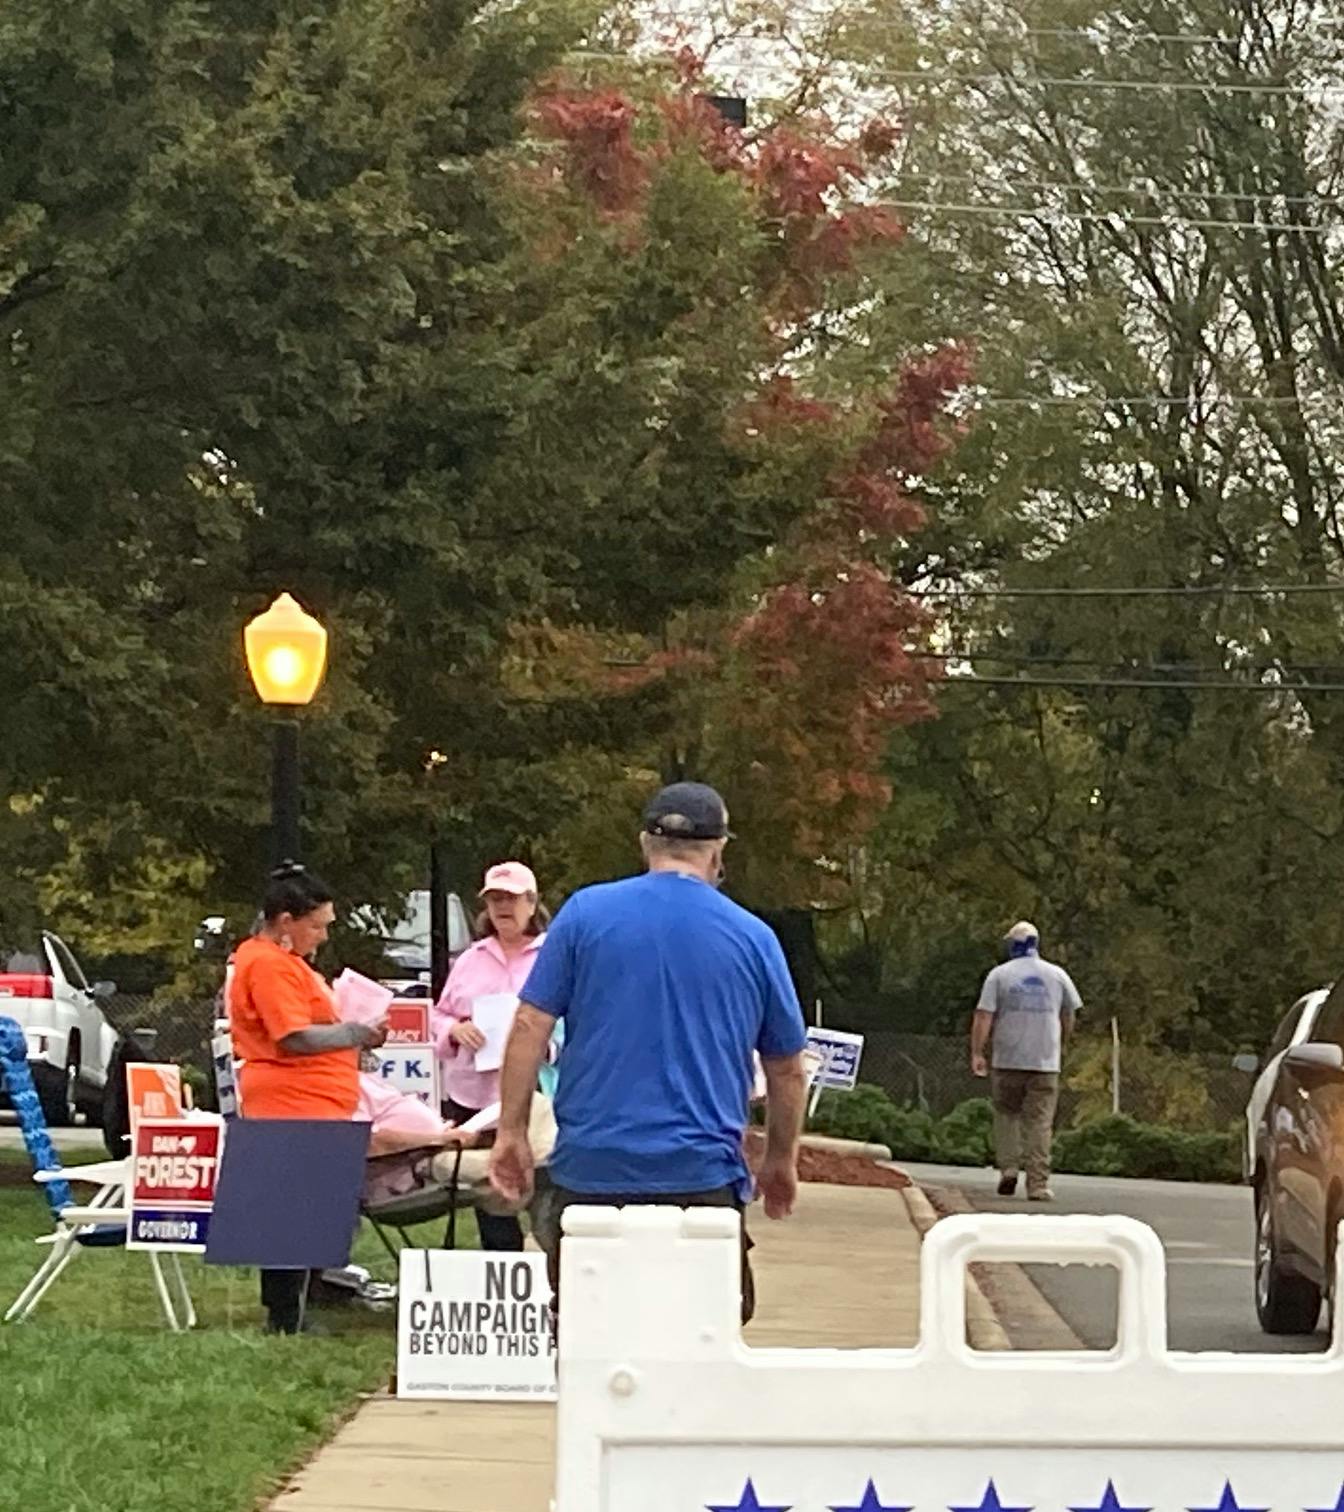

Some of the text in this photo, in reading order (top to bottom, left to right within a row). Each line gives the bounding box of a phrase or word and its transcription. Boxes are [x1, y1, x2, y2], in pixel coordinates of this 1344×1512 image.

[405, 1060, 430, 1078] K.
[136, 1156, 215, 1190] FOREST
[137, 1219, 198, 1240] GOVERNOR
[485, 1261, 533, 1302] NO
[409, 1333, 488, 1355] BEYOND
[496, 1334, 539, 1357] THIS
